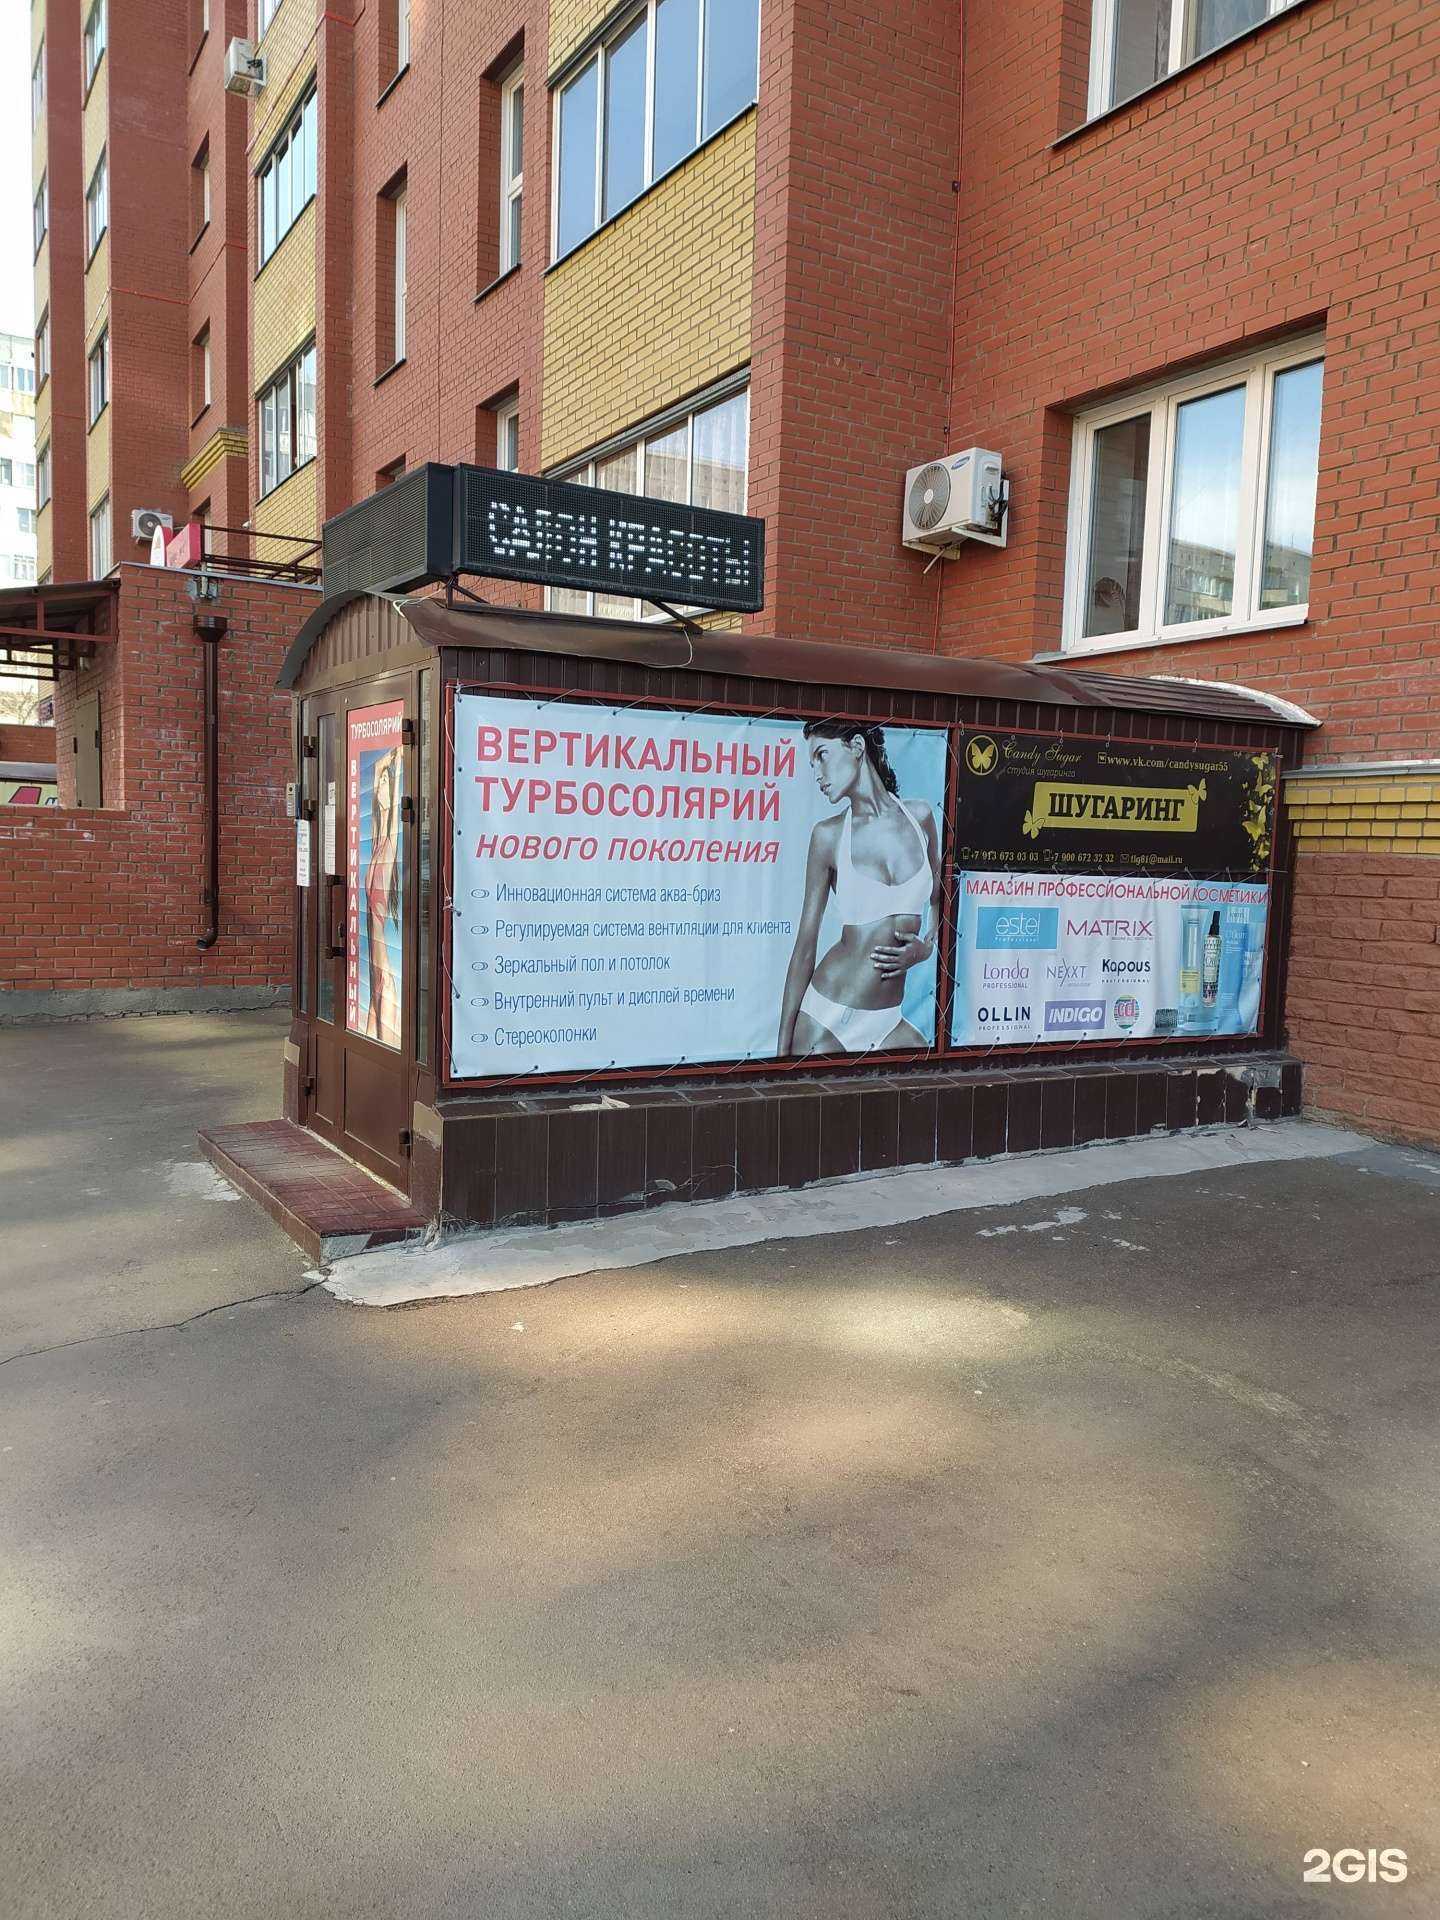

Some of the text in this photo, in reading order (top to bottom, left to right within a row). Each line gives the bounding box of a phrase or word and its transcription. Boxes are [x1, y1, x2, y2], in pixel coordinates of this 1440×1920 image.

[488, 501, 750, 585] САЛОН КРАСОТЫ
[350, 711, 403, 740] ТУРБОСОЛЯРИЙ
[475, 725, 797, 779] ВЕРТИКАЛЬНЫЙ
[474, 775, 781, 822] ТУРБОСОЛЯРИЙ
[1047, 792, 1185, 822] ШУГАРИНГ
[475, 834, 780, 865] нового поколения
[349, 758, 358, 1025] ВЕРТИКАЛЬНЫЙ
[495, 883, 722, 906] Инновационная система аква-бриз
[965, 879, 1269, 905] МАГАЗИН ПРОФЕССИОНАЛЬНОЙ КОСМЕТИКИ
[494, 919, 792, 942] Регулируемая система вентиляции для клиента
[995, 912, 1041, 935] estel
[1066, 919, 1153, 937] MATRIX
[494, 954, 672, 978] Зеркальный пол и потолок
[983, 957, 1030, 980] Londa
[1101, 958, 1152, 976] Kapous
[494, 985, 736, 1013] Внутренний пульт и дисплей времени
[977, 1006, 1031, 1022] OLLIN
[1049, 1006, 1103, 1024] INDIGO
[494, 1025, 598, 1048] Стереоколонки
